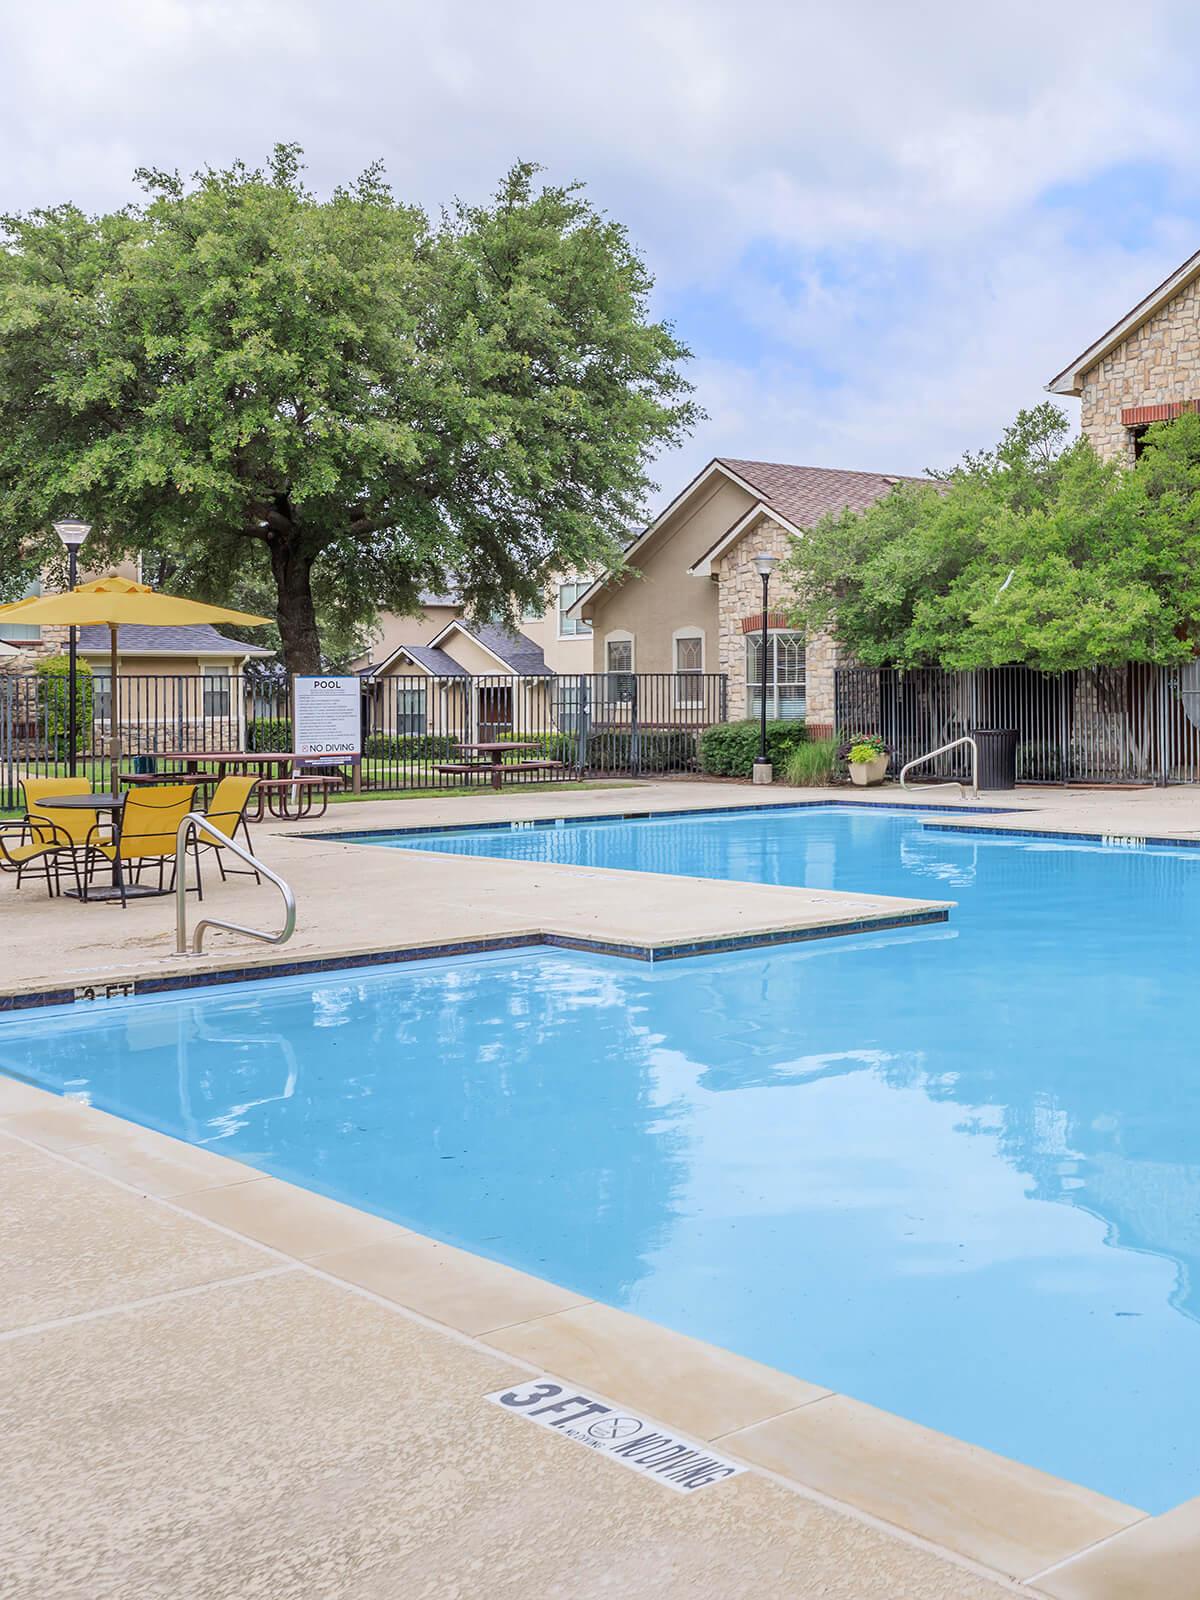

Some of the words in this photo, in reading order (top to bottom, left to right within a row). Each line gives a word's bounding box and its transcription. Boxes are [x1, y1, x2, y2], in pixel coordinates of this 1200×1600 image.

[325, 743, 355, 752] DIVING
[500, 1384, 562, 1407] 3
[611, 1432, 673, 1458] NO
[633, 1445, 735, 1490] DIVING
